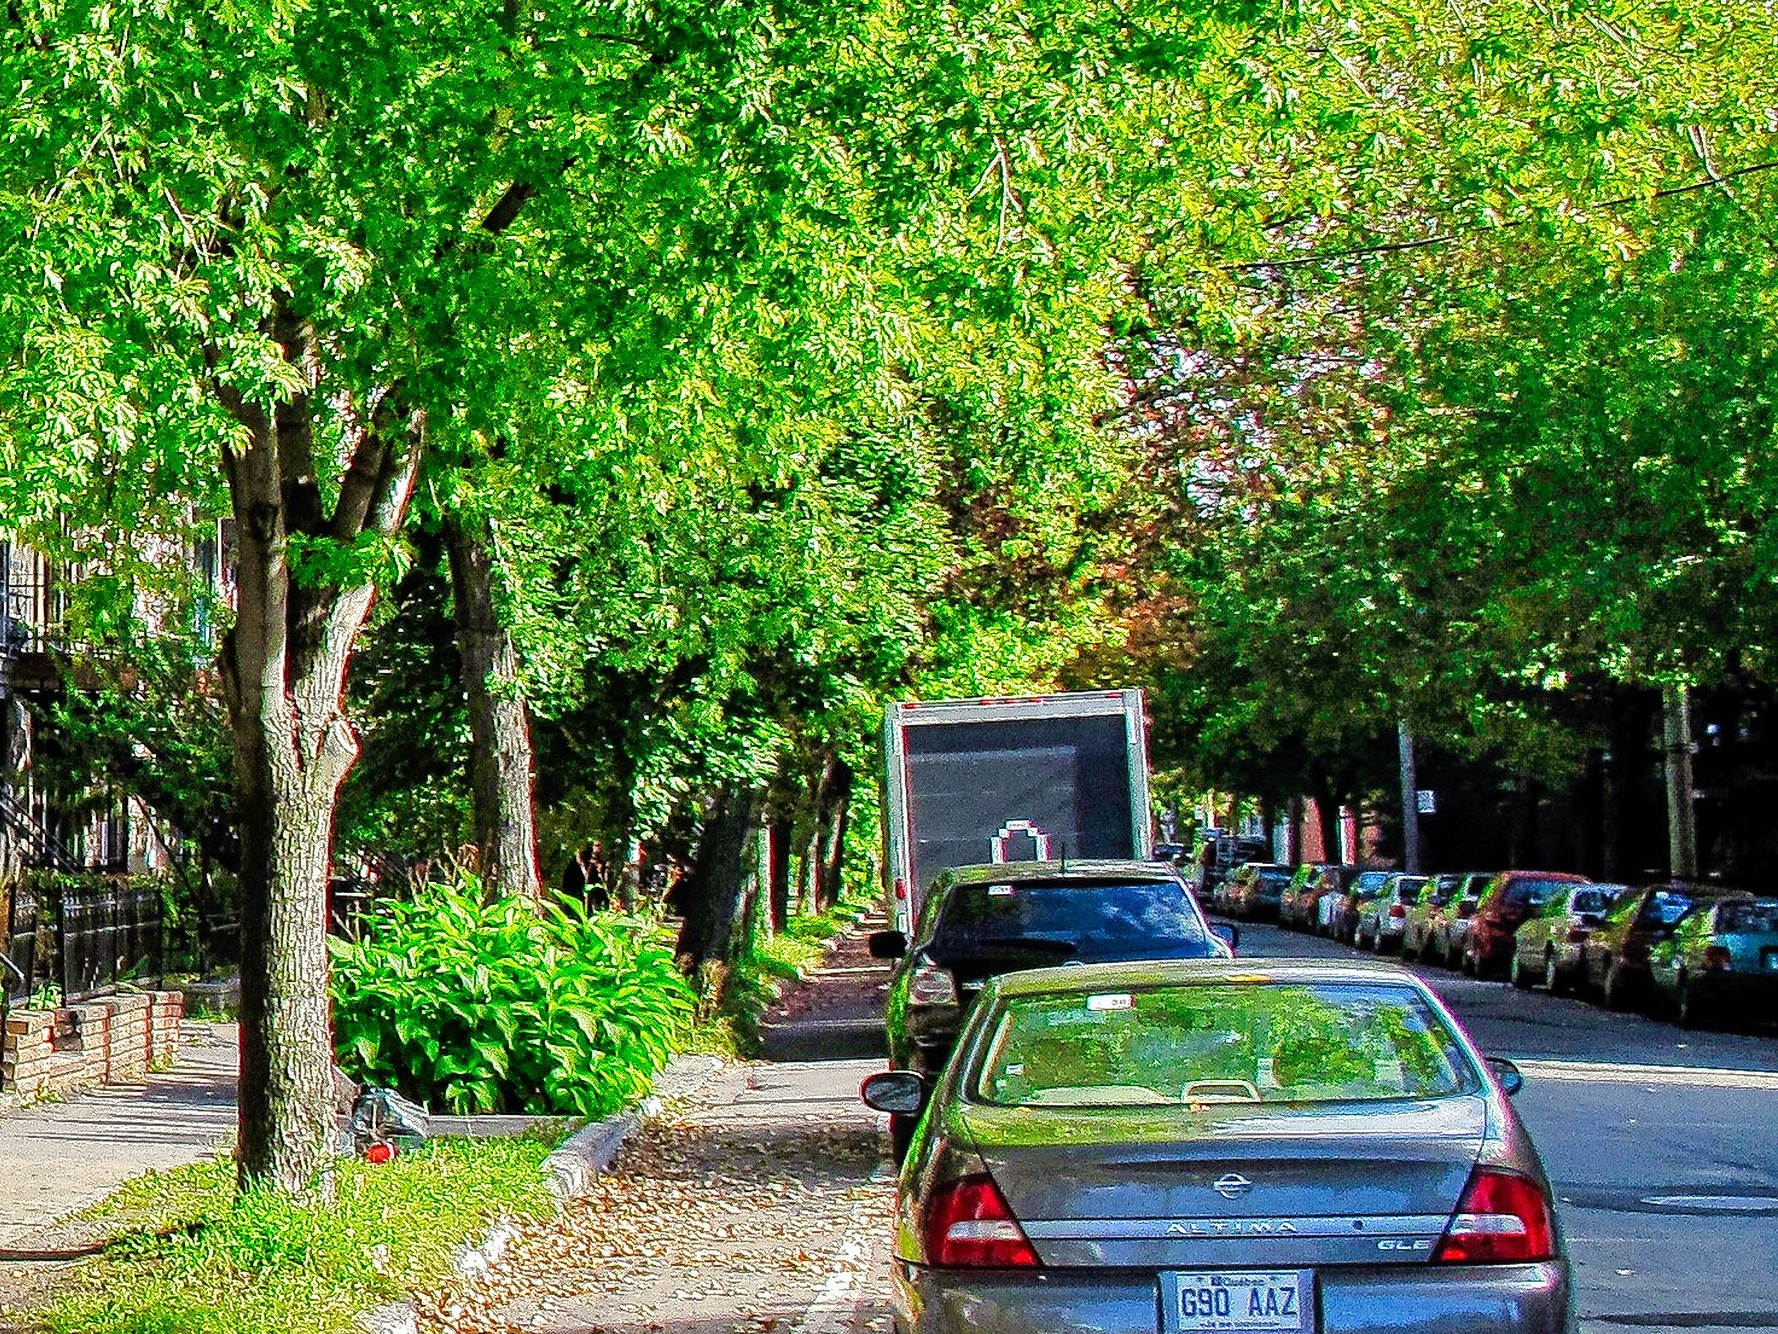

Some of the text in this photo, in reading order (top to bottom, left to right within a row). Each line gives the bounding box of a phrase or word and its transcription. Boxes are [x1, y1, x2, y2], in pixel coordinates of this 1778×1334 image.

[1165, 1222, 1297, 1235] ALTIMA
[1377, 1239, 1432, 1251] GLE
[1181, 1286, 1298, 1317] G90 AAZ
